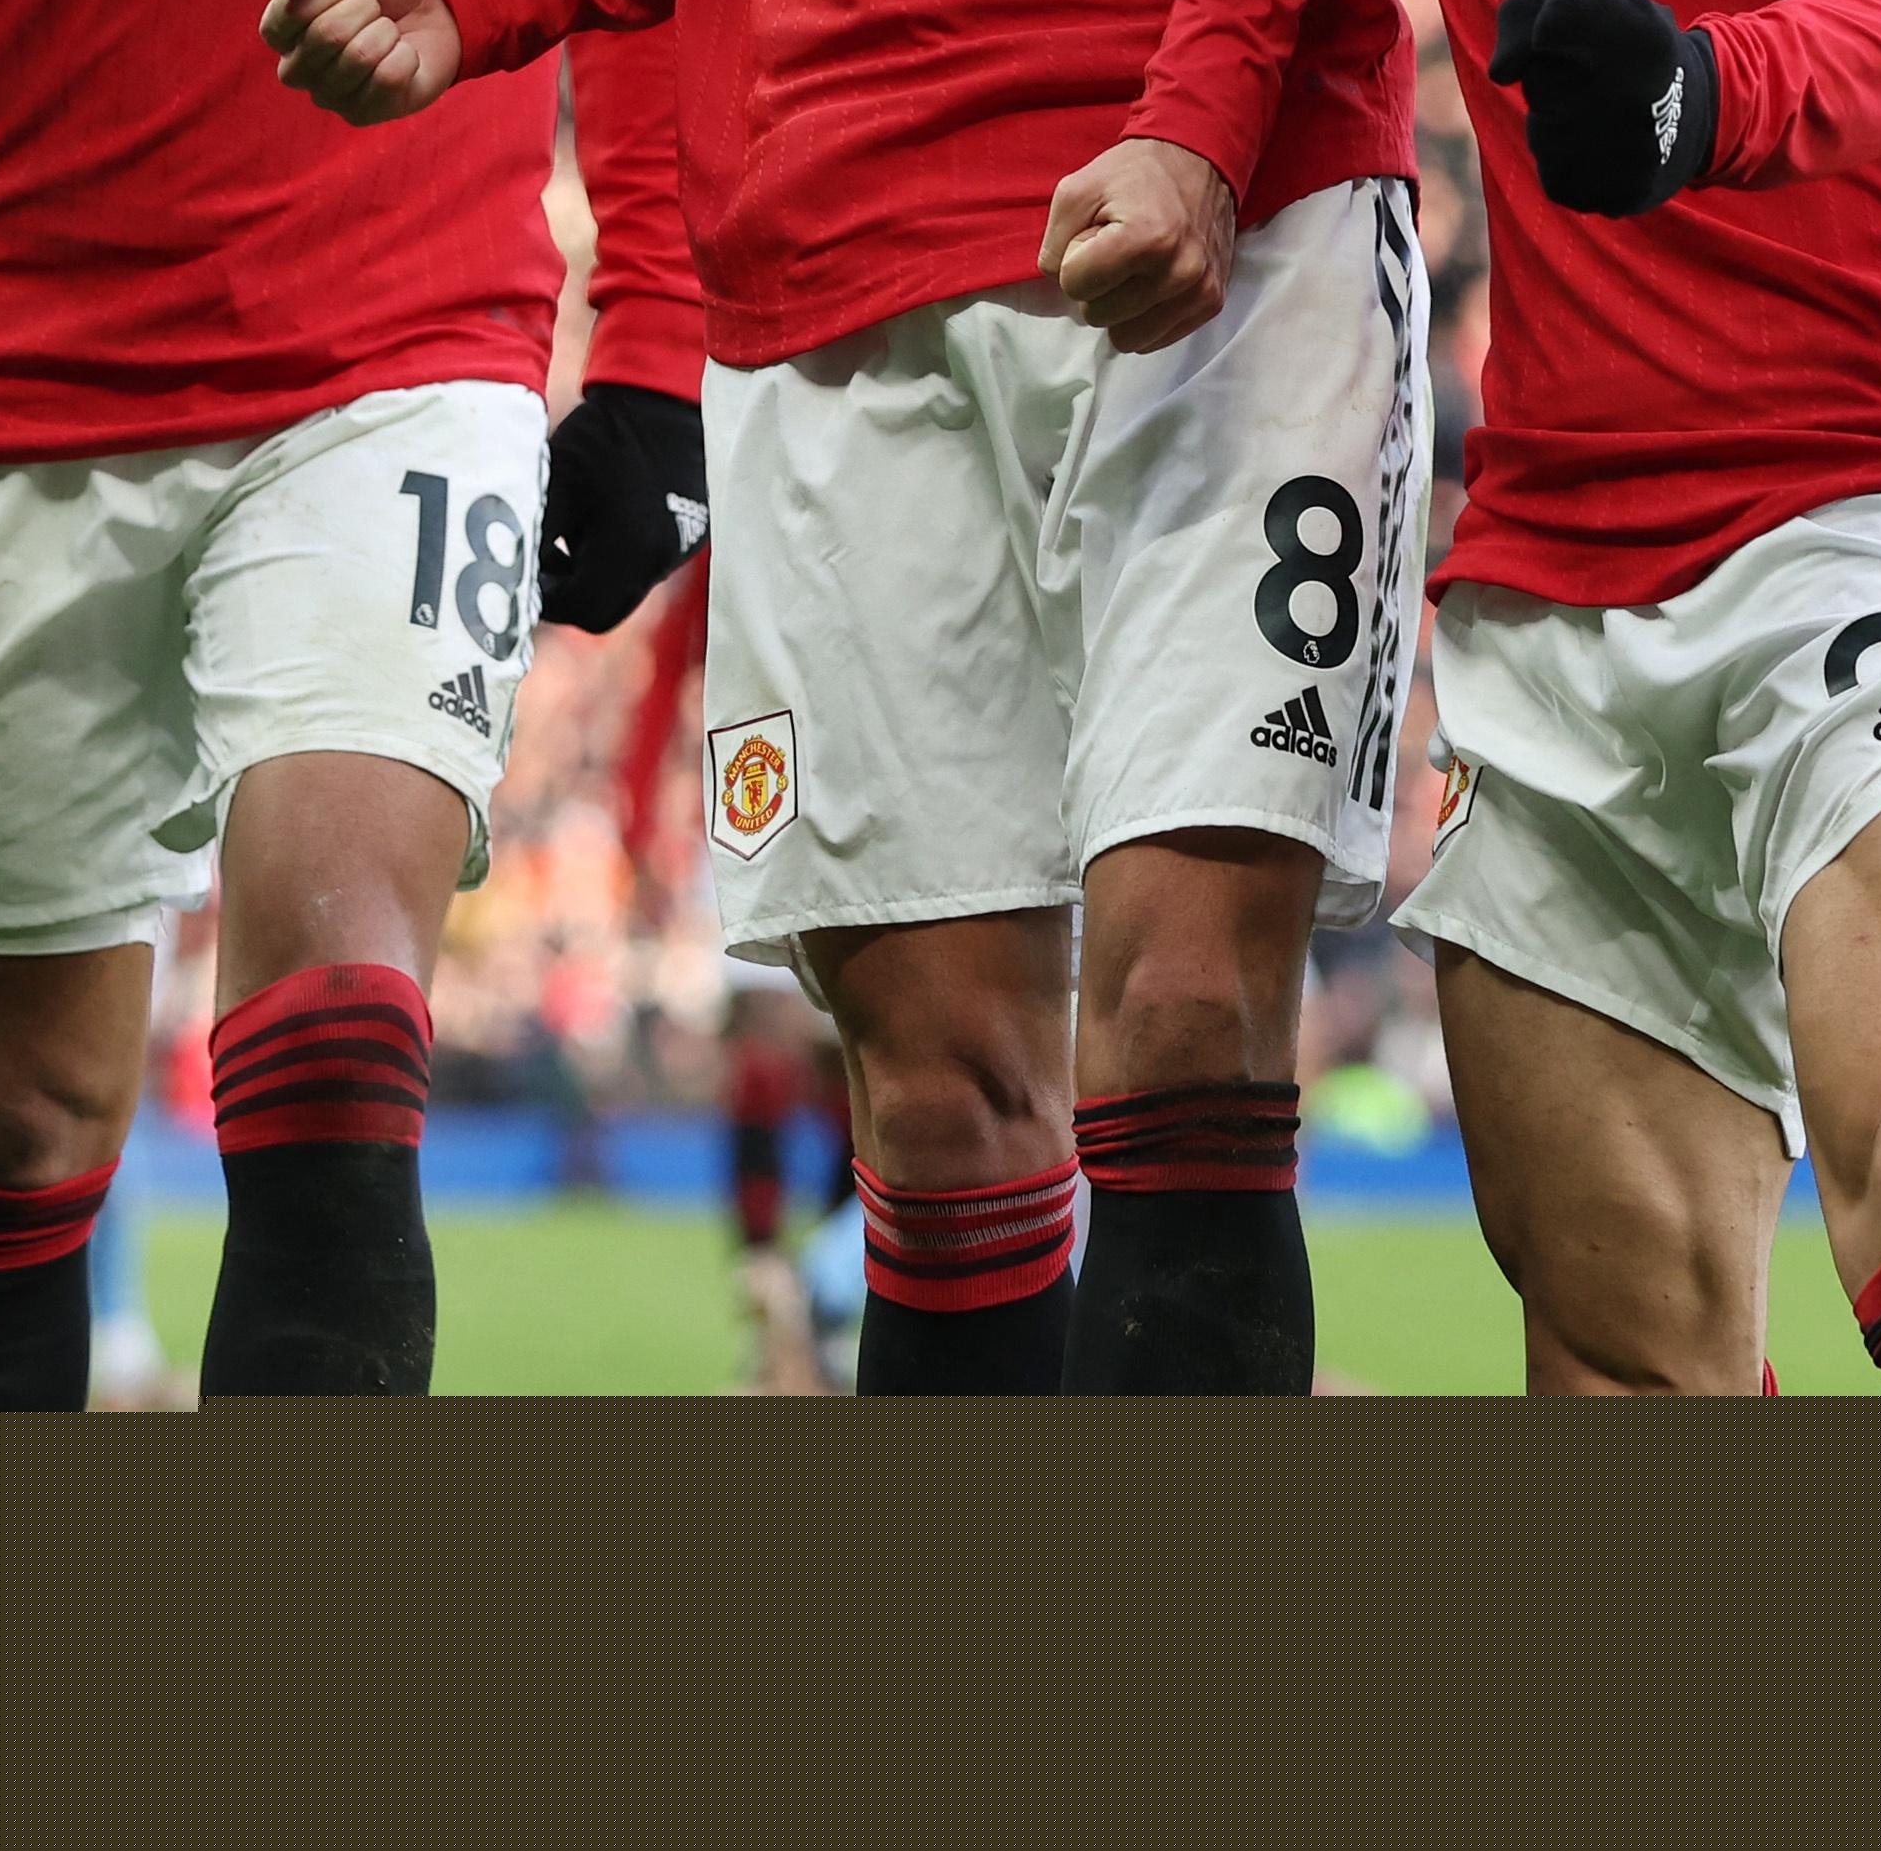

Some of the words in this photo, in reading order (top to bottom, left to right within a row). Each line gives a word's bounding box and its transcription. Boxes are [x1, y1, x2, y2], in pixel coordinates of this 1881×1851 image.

[399, 469, 525, 662] 18
[1254, 475, 1364, 670] 8
[728, 742, 782, 782] MANCHESTER
[1250, 725, 1338, 769] adidas
[735, 808, 774, 829] UNITED
